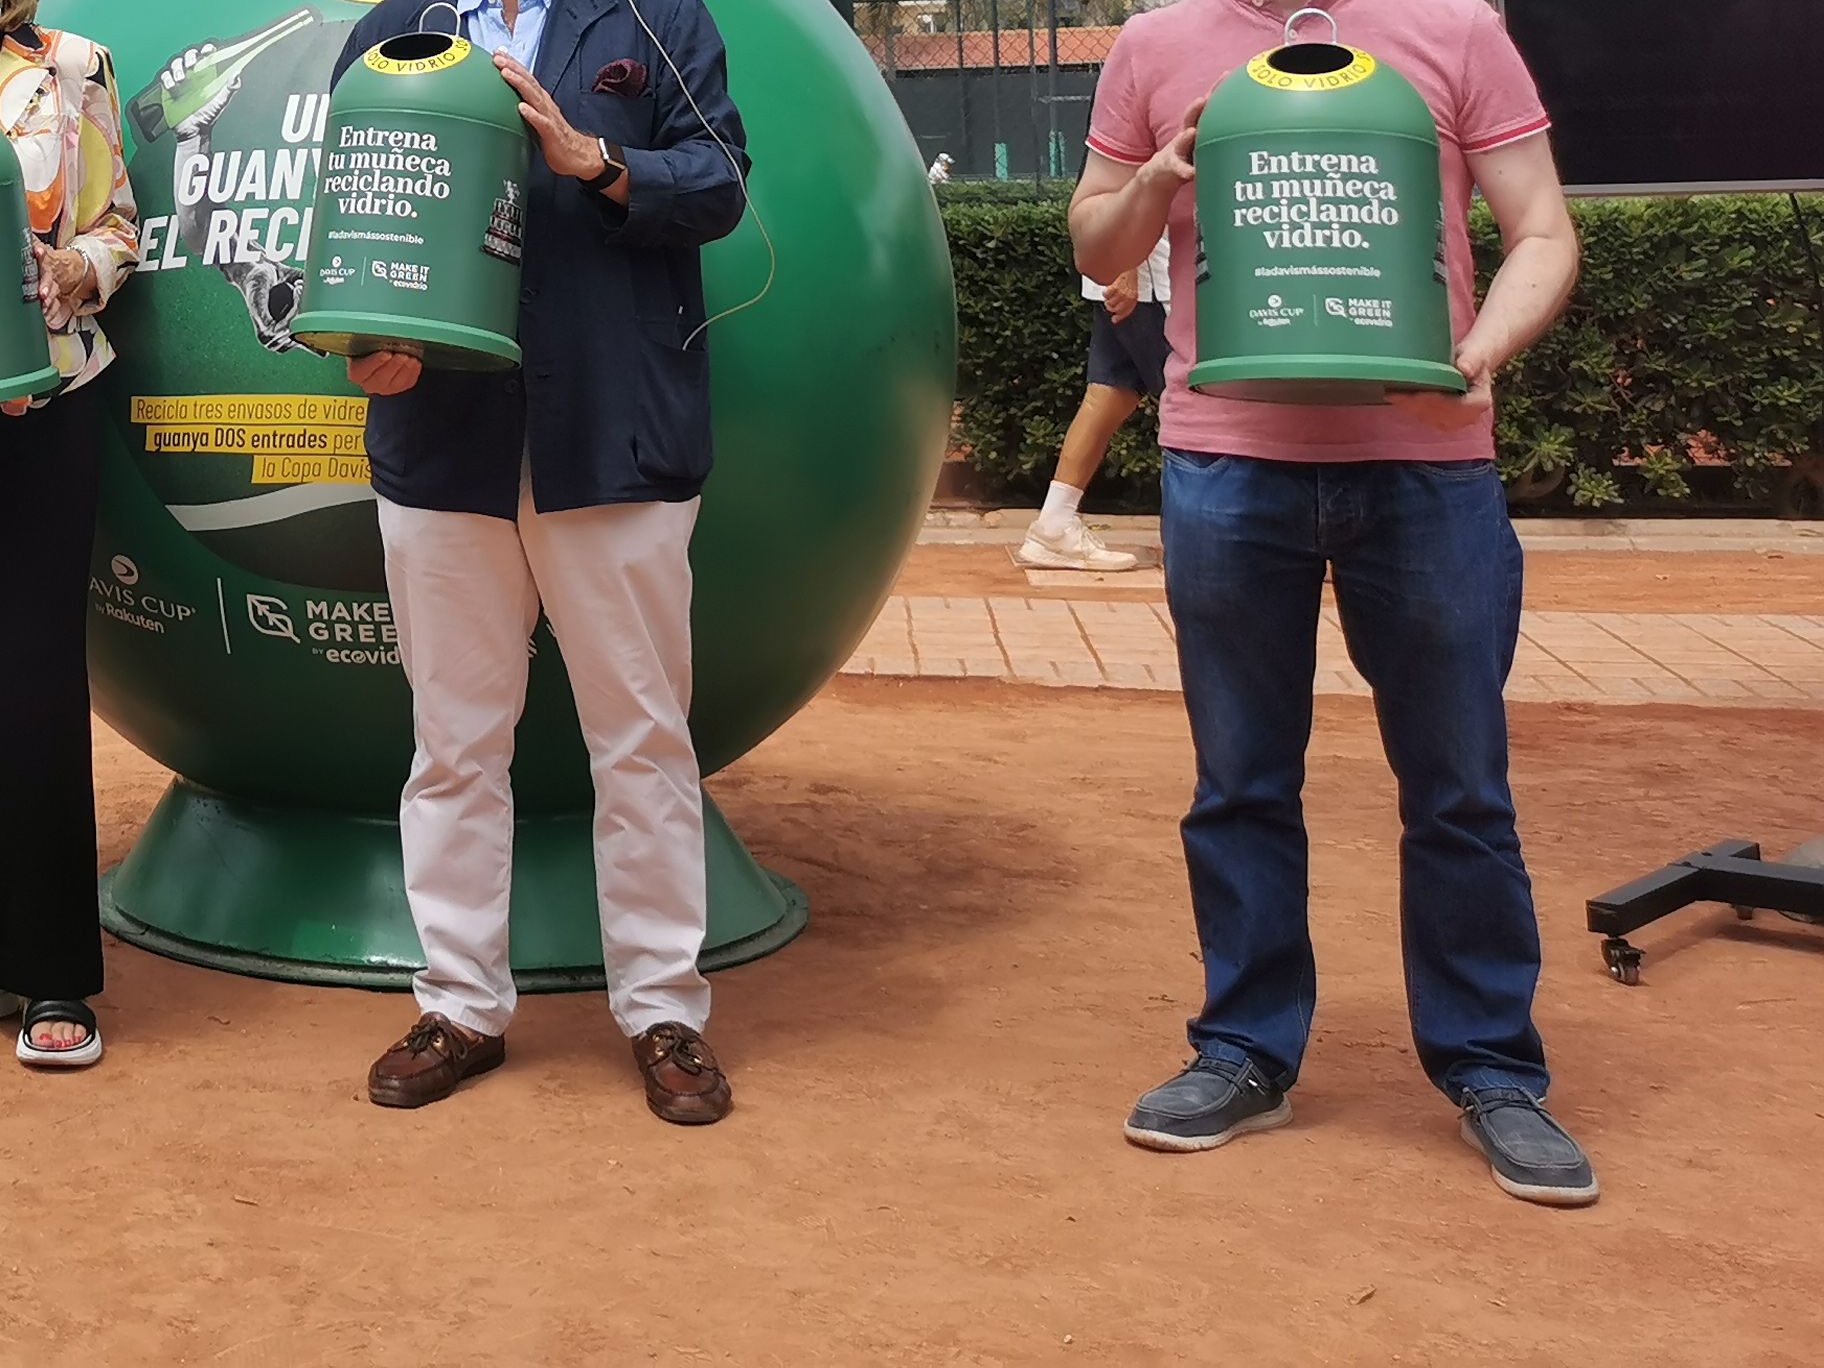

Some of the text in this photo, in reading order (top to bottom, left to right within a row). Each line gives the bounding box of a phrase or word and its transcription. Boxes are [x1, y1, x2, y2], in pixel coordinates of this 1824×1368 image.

[397, 52, 455, 72] VIDRIO
[1252, 64, 1366, 88] SOLO VIDRIO
[339, 126, 437, 151] Entrena
[328, 148, 451, 176] tu muñeca
[1249, 151, 1379, 175] Entrena
[323, 169, 450, 199] reciclando
[1234, 172, 1397, 201] tu muñeca
[338, 192, 418, 218] vidrio.
[1233, 197, 1399, 227] reciclando
[135, 215, 187, 272] EL
[1263, 222, 1370, 249] vidrio.
[390, 262, 430, 275] MAKE IT
[390, 270, 427, 282] GREEN
[1280, 307, 1304, 317] CUP
[1348, 298, 1393, 309] MAKE IT
[1348, 307, 1392, 317] GREEN
[137, 398, 364, 421] Recicla tres envasos de vidre
[154, 428, 361, 455] guanya DOS entrades per
[262, 459, 372, 483] la Copa Davis
[88, 577, 194, 620] AVIS CUP
[305, 599, 390, 620] MAKE
[105, 602, 165, 633] Rakuten
[308, 623, 398, 643] GREE
[326, 646, 401, 665] ecovid
